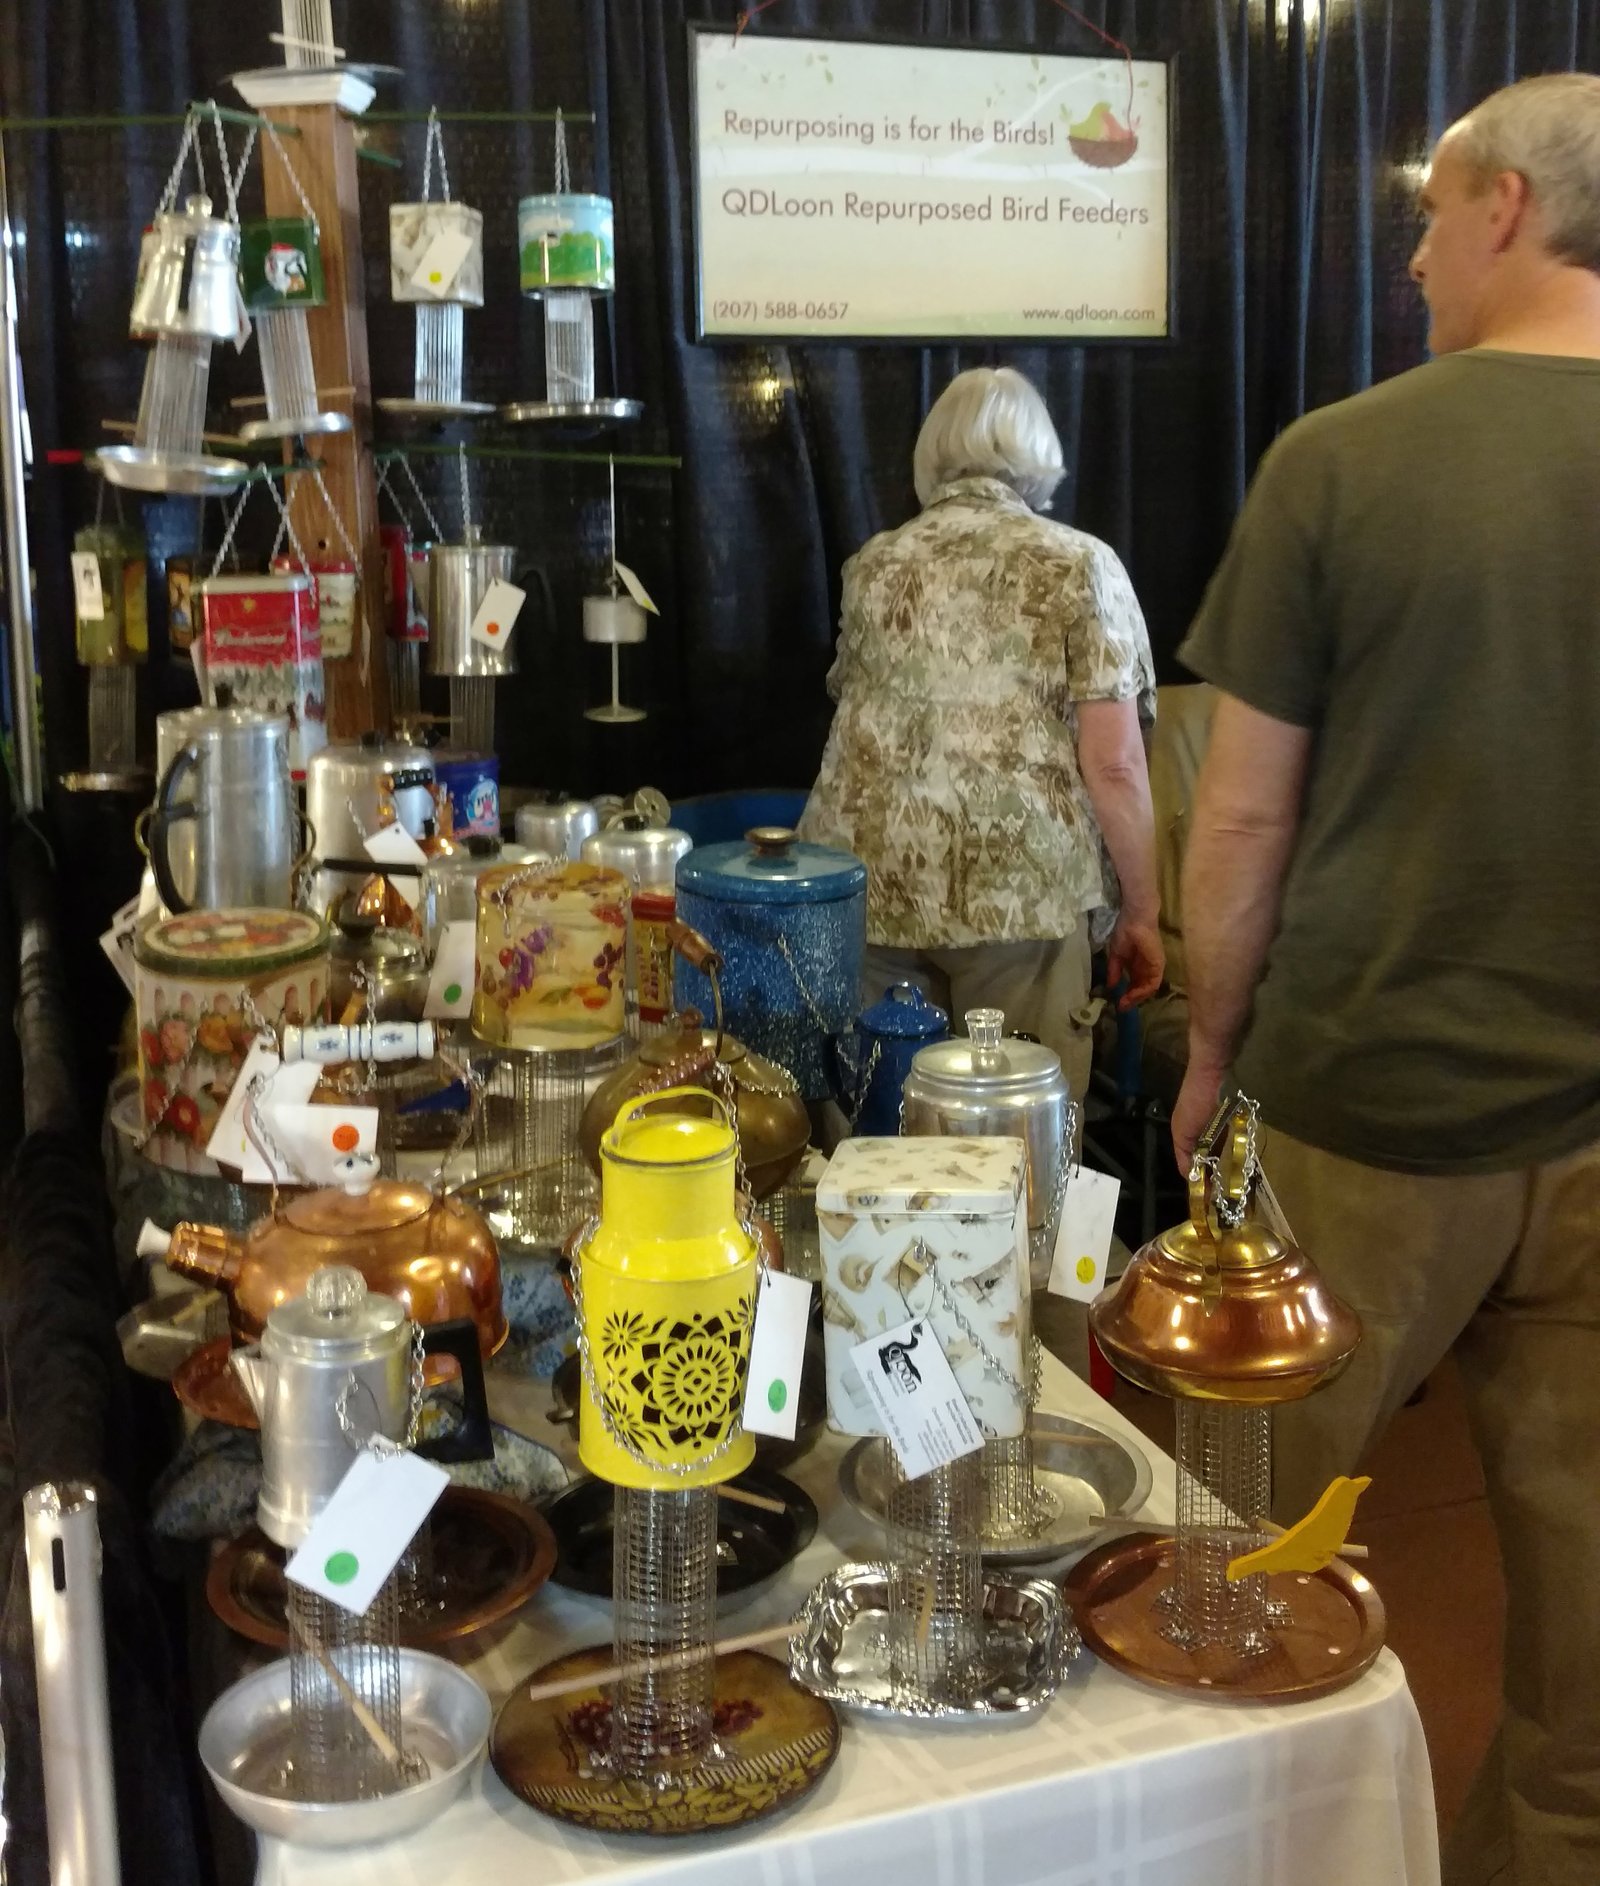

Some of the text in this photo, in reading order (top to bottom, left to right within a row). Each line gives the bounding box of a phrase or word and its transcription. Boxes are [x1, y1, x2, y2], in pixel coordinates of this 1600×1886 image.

[724, 109, 1054, 146] Repurposing is for the Birds!
[722, 187, 1150, 226] QDLoon Repurposed Bird Feeders
[712, 300, 848, 322] (207) 588-0657
[1022, 303, 1156, 324] www.qdloon.com
